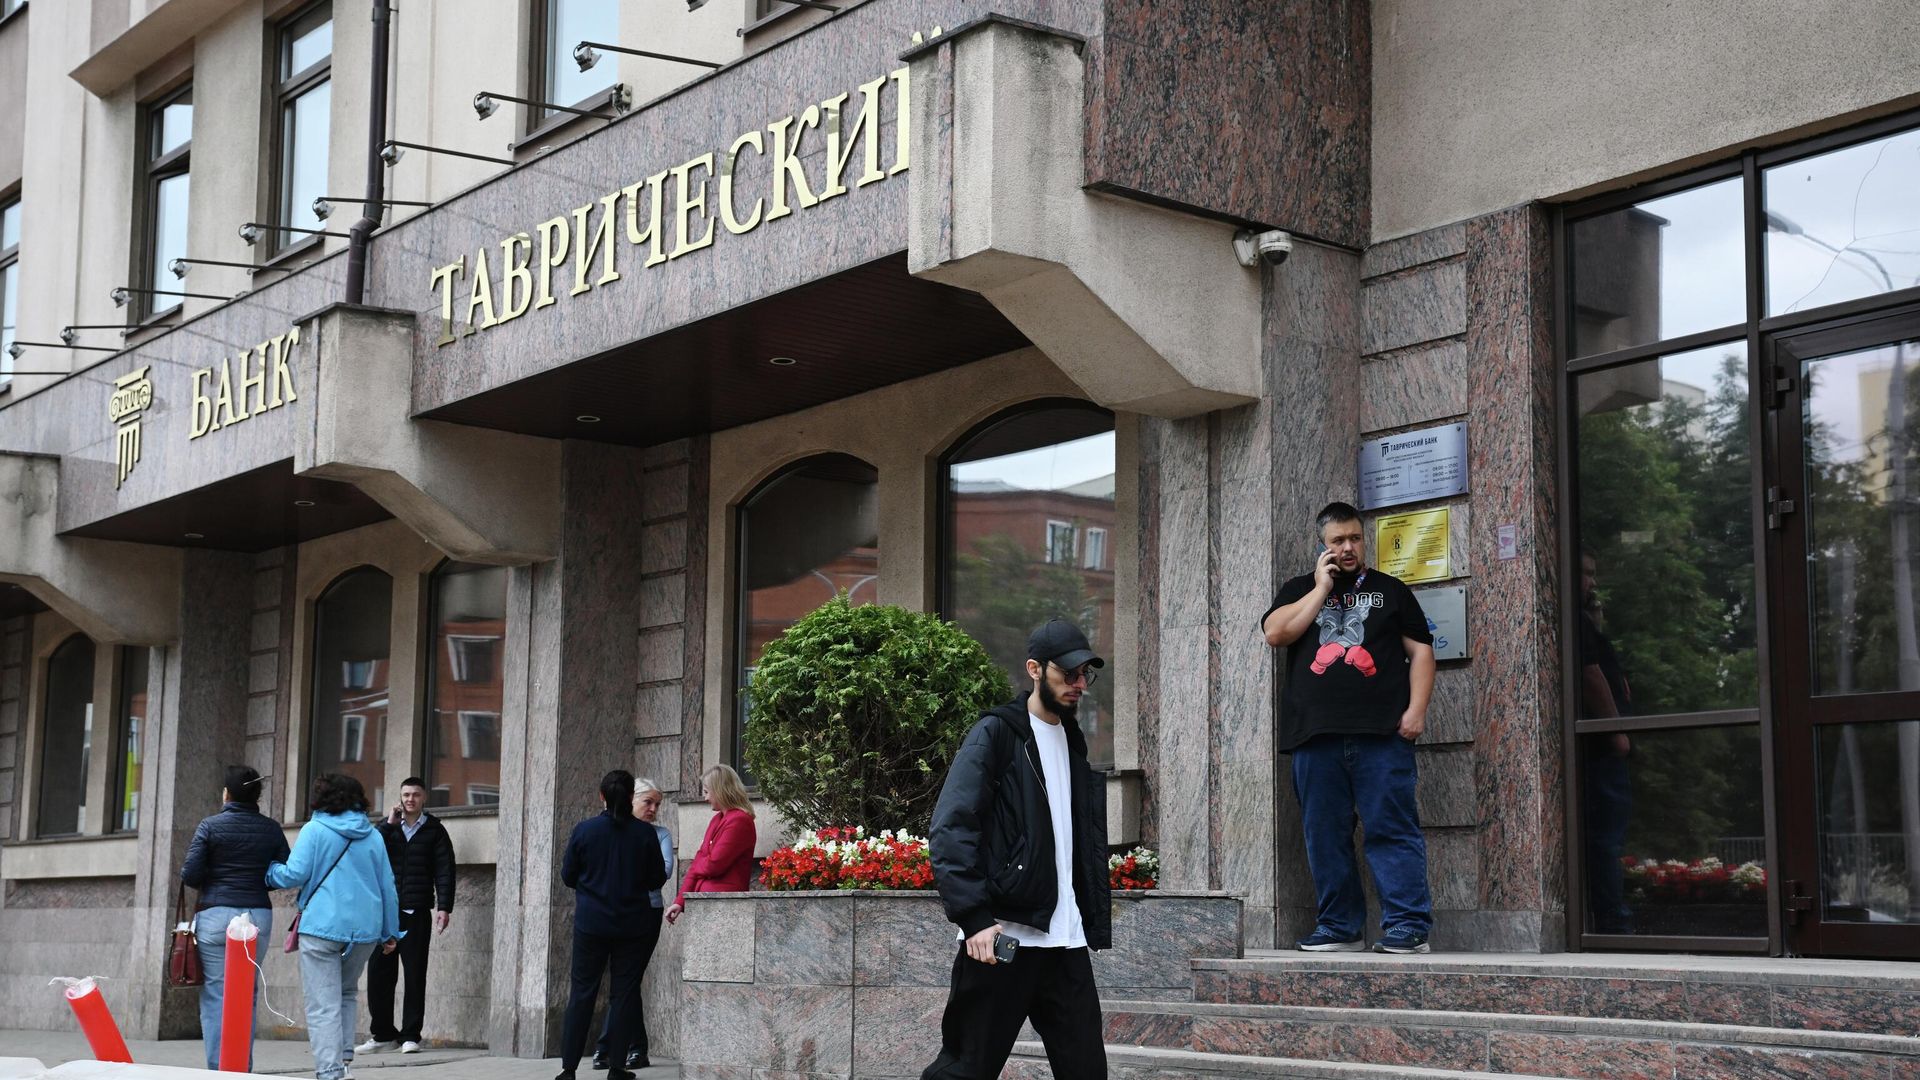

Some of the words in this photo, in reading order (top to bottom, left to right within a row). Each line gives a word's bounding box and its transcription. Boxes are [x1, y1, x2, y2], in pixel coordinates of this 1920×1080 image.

[189, 328, 299, 441] БАНК
[1390, 438, 1423, 451] ТАВРИЧЕСКИЙ
[1425, 436, 1438, 446] БАНК
[1343, 592, 1384, 610] DOG
